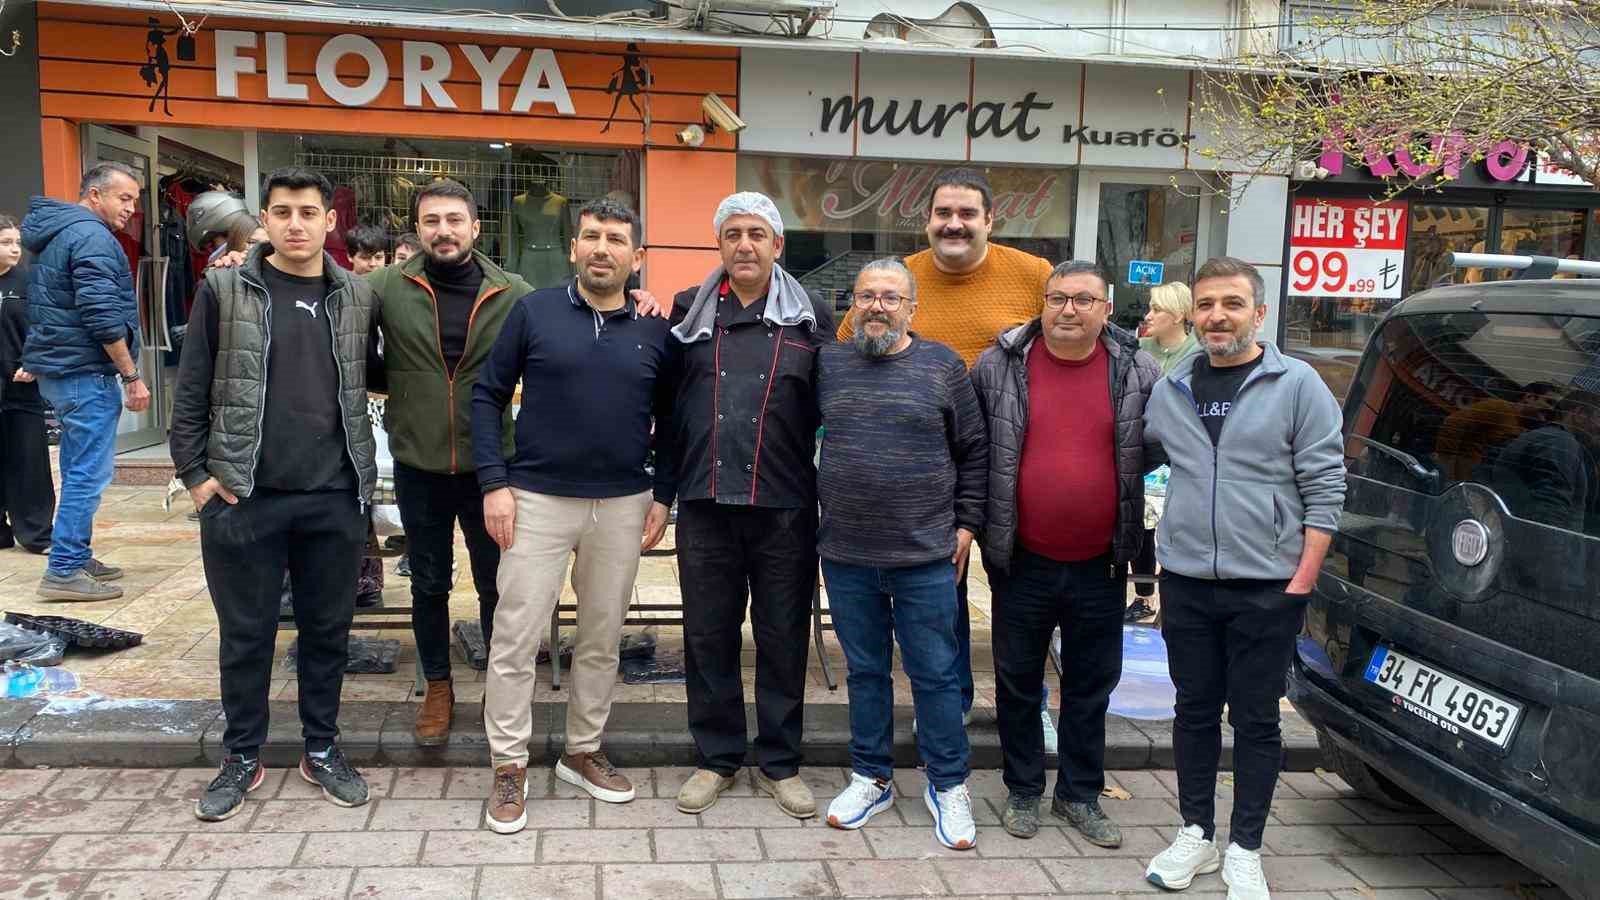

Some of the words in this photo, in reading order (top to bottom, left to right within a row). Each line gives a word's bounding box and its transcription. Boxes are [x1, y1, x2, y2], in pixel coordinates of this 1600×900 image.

[214, 29, 576, 115] FLORYA
[820, 92, 1054, 141] murat
[1293, 204, 1344, 239] HER
[1353, 207, 1403, 248] ŞEY
[1293, 250, 1375, 292] 99.99
[1378, 654, 1406, 690] 34
[1408, 667, 1442, 706] FK
[1444, 685, 1510, 738] 4963
[1440, 719, 1459, 734] OTO
